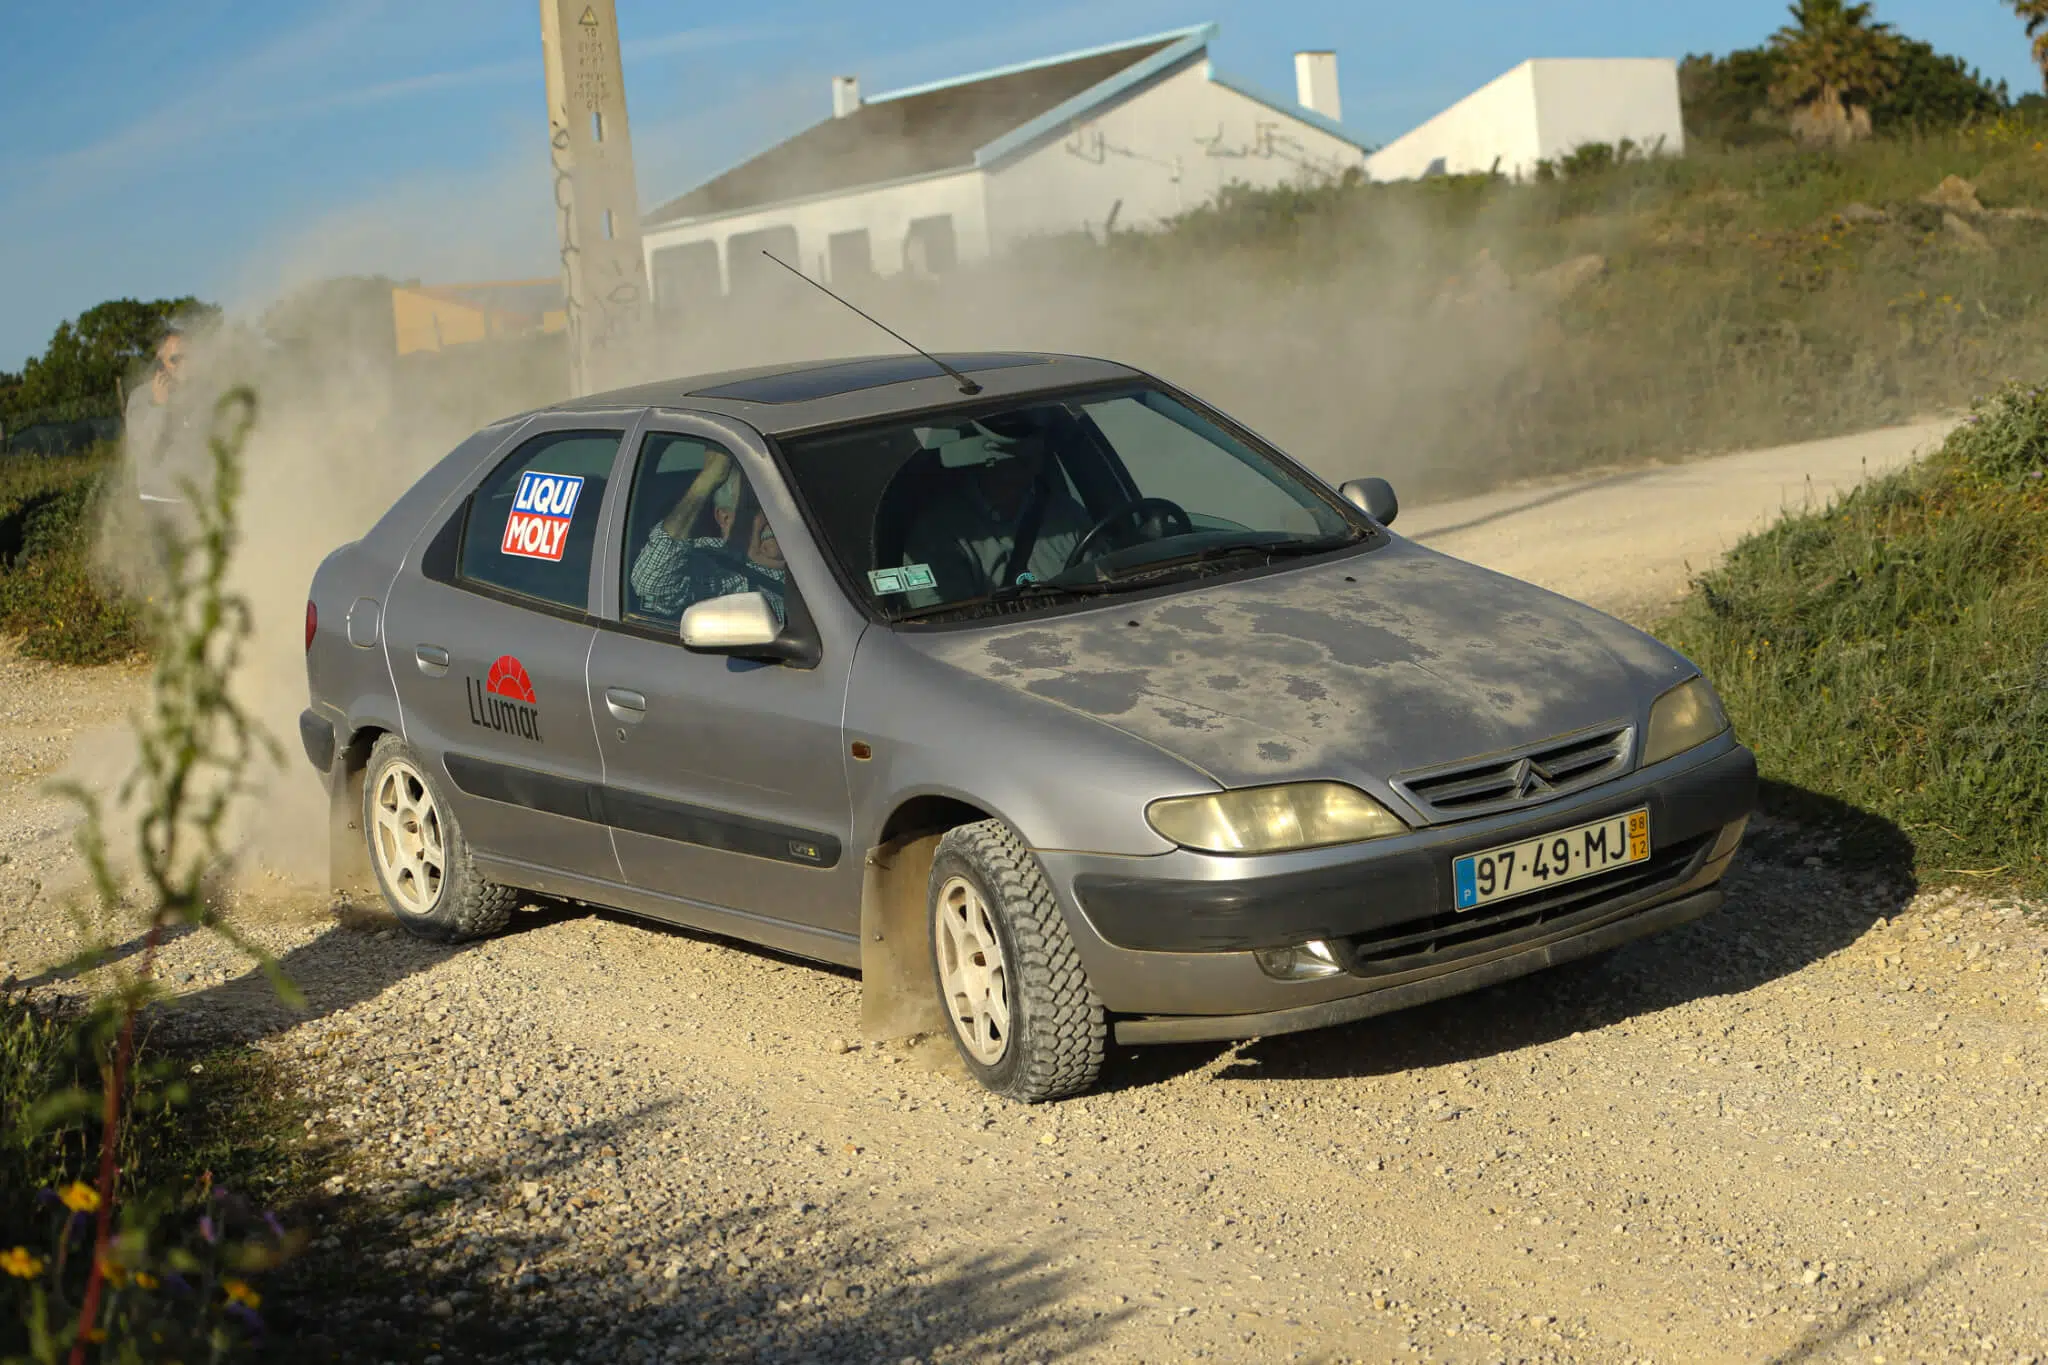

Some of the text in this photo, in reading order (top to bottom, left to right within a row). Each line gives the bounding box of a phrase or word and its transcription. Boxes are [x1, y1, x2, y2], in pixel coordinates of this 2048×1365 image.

[516, 476, 580, 515] LIQUI
[506, 515, 568, 555] MOLY
[466, 676, 540, 741] LLumar
[1630, 816, 1646, 831] 98
[1632, 840, 1647, 857] 12
[1464, 889, 1472, 901] P
